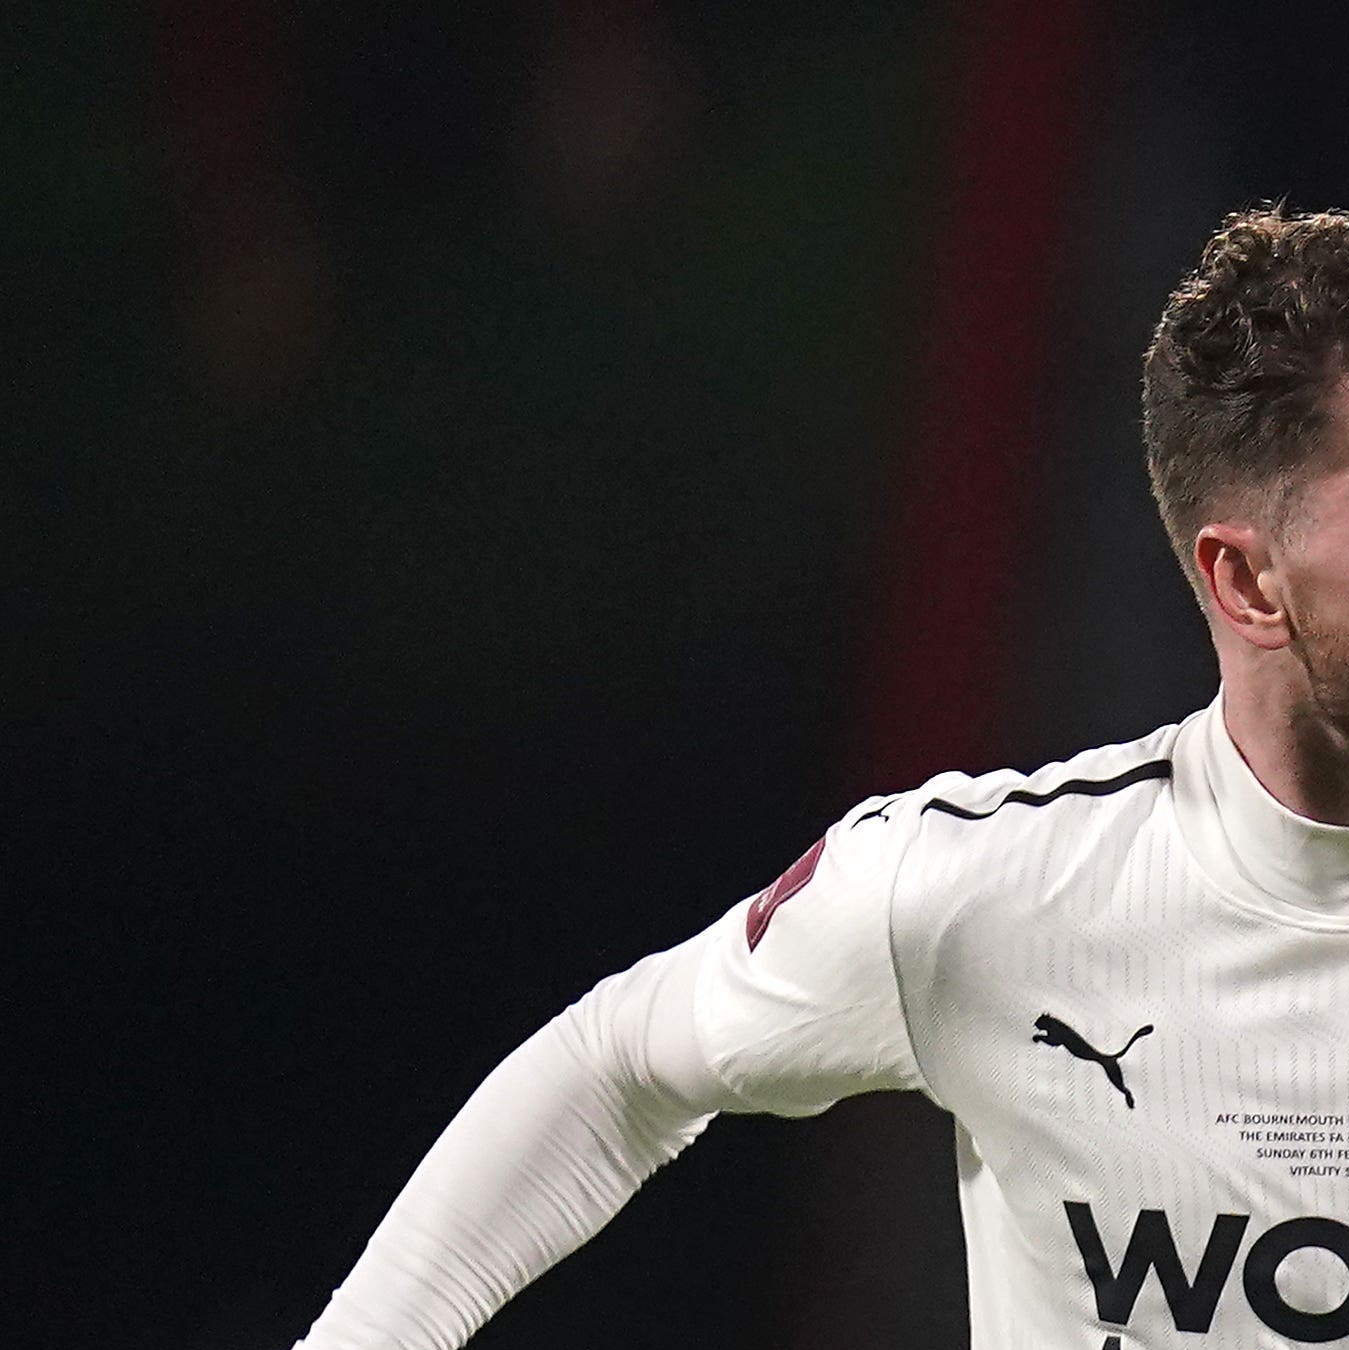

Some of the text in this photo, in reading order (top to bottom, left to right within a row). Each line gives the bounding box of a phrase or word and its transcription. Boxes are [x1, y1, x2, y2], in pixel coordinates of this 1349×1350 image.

[1215, 1114, 1238, 1125] AFC
[1244, 1114, 1344, 1126] BOURNEMOUTH
[1239, 1131, 1262, 1142] THE
[1266, 1131, 1325, 1143] EMIRATES
[1329, 1132, 1344, 1143] FA
[1256, 1148, 1305, 1159] SUNDAY
[1309, 1149, 1333, 1160] 6TH
[1290, 1165, 1340, 1177] VITALITY
